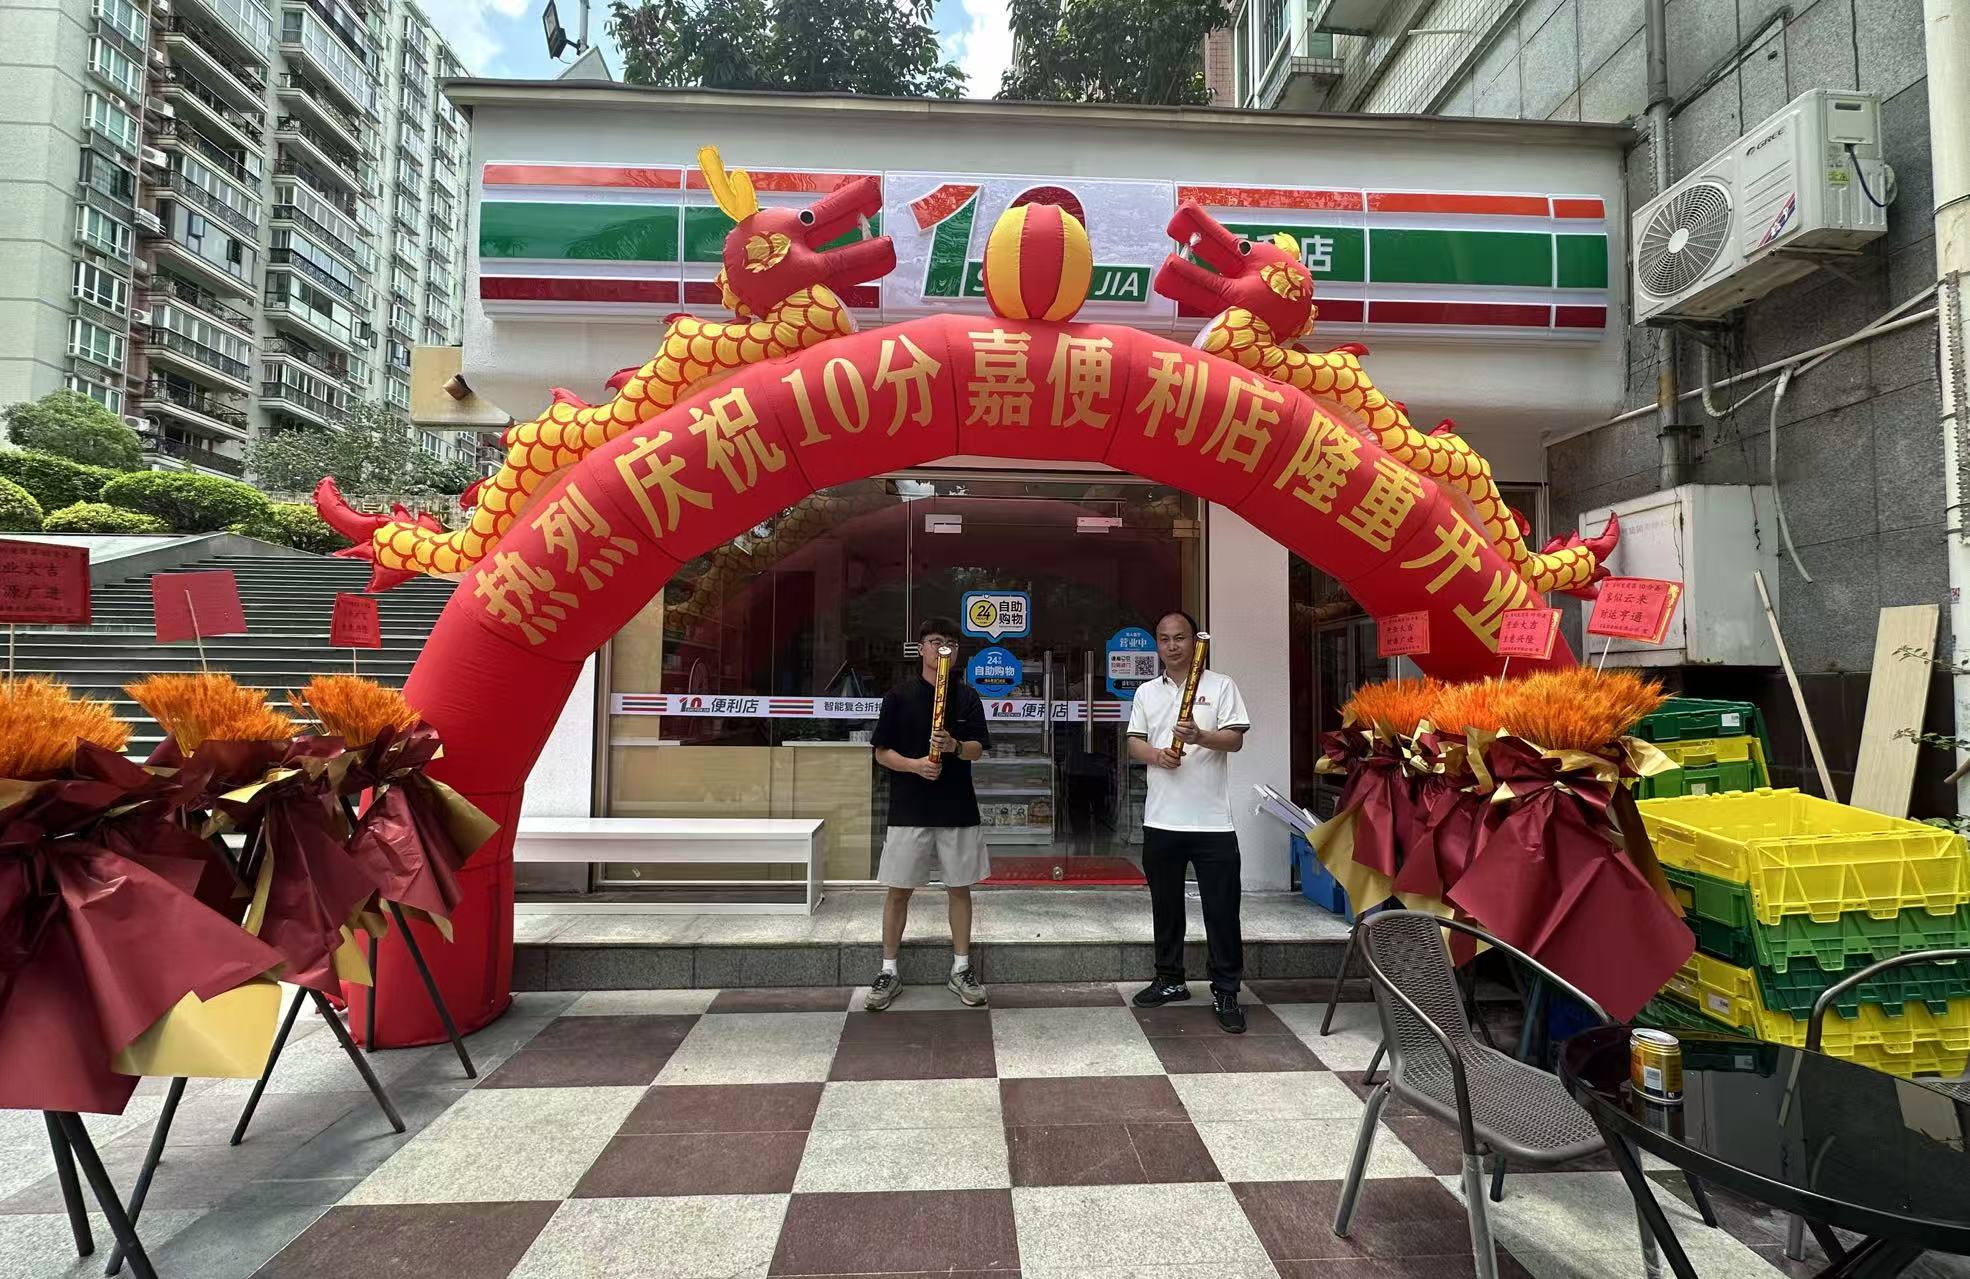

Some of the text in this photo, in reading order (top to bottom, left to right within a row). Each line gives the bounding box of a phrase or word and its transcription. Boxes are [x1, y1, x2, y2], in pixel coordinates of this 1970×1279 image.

[1757, 127, 1785, 149] GREE
[1095, 272, 1138, 297] JIA
[1000, 600, 1023, 612] 自助
[999, 613, 1023, 625] 购物
[1120, 638, 1147, 648] 营业中
[975, 666, 1015, 676] 自助购物
[711, 698, 759, 713] 便利店
